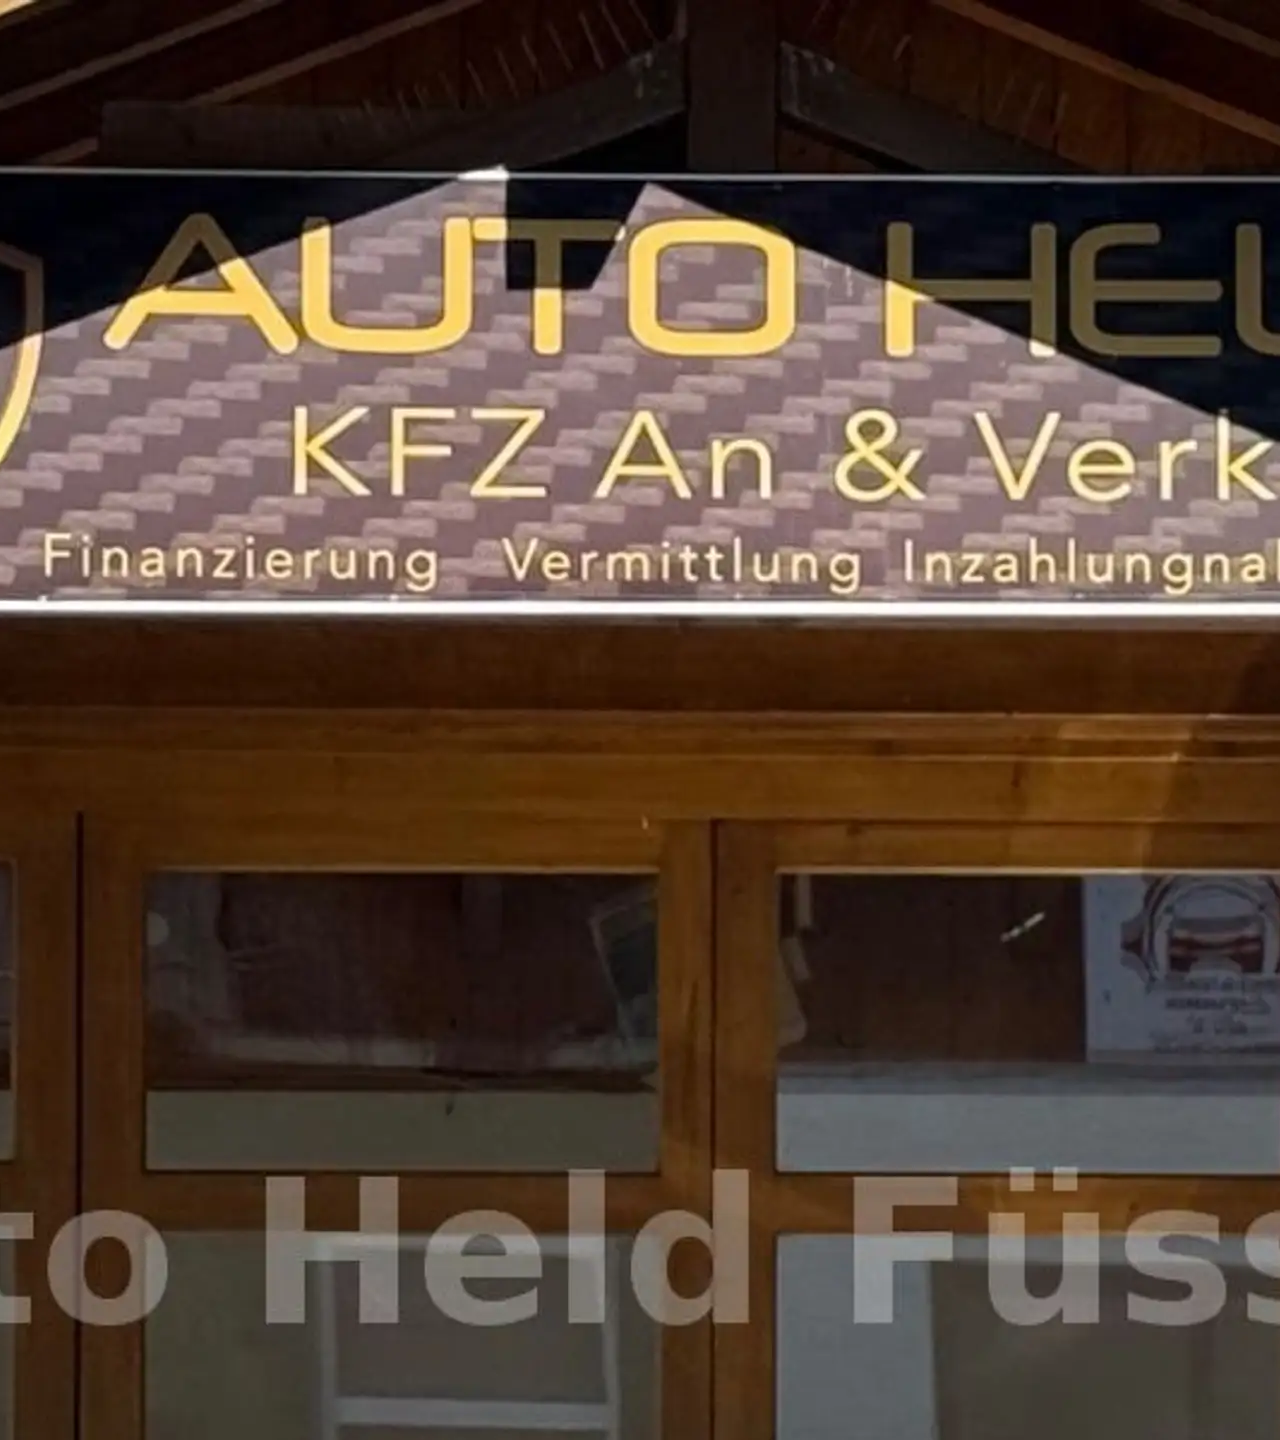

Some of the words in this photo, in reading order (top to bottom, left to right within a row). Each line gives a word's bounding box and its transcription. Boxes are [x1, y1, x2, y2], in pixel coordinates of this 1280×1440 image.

[103, 212, 797, 357] AUTO
[292, 406, 547, 499] KFZ
[595, 410, 773, 500] An
[834, 409, 926, 502] &
[43, 533, 440, 592] Finanzierung
[502, 537, 862, 594] Vermittlung
